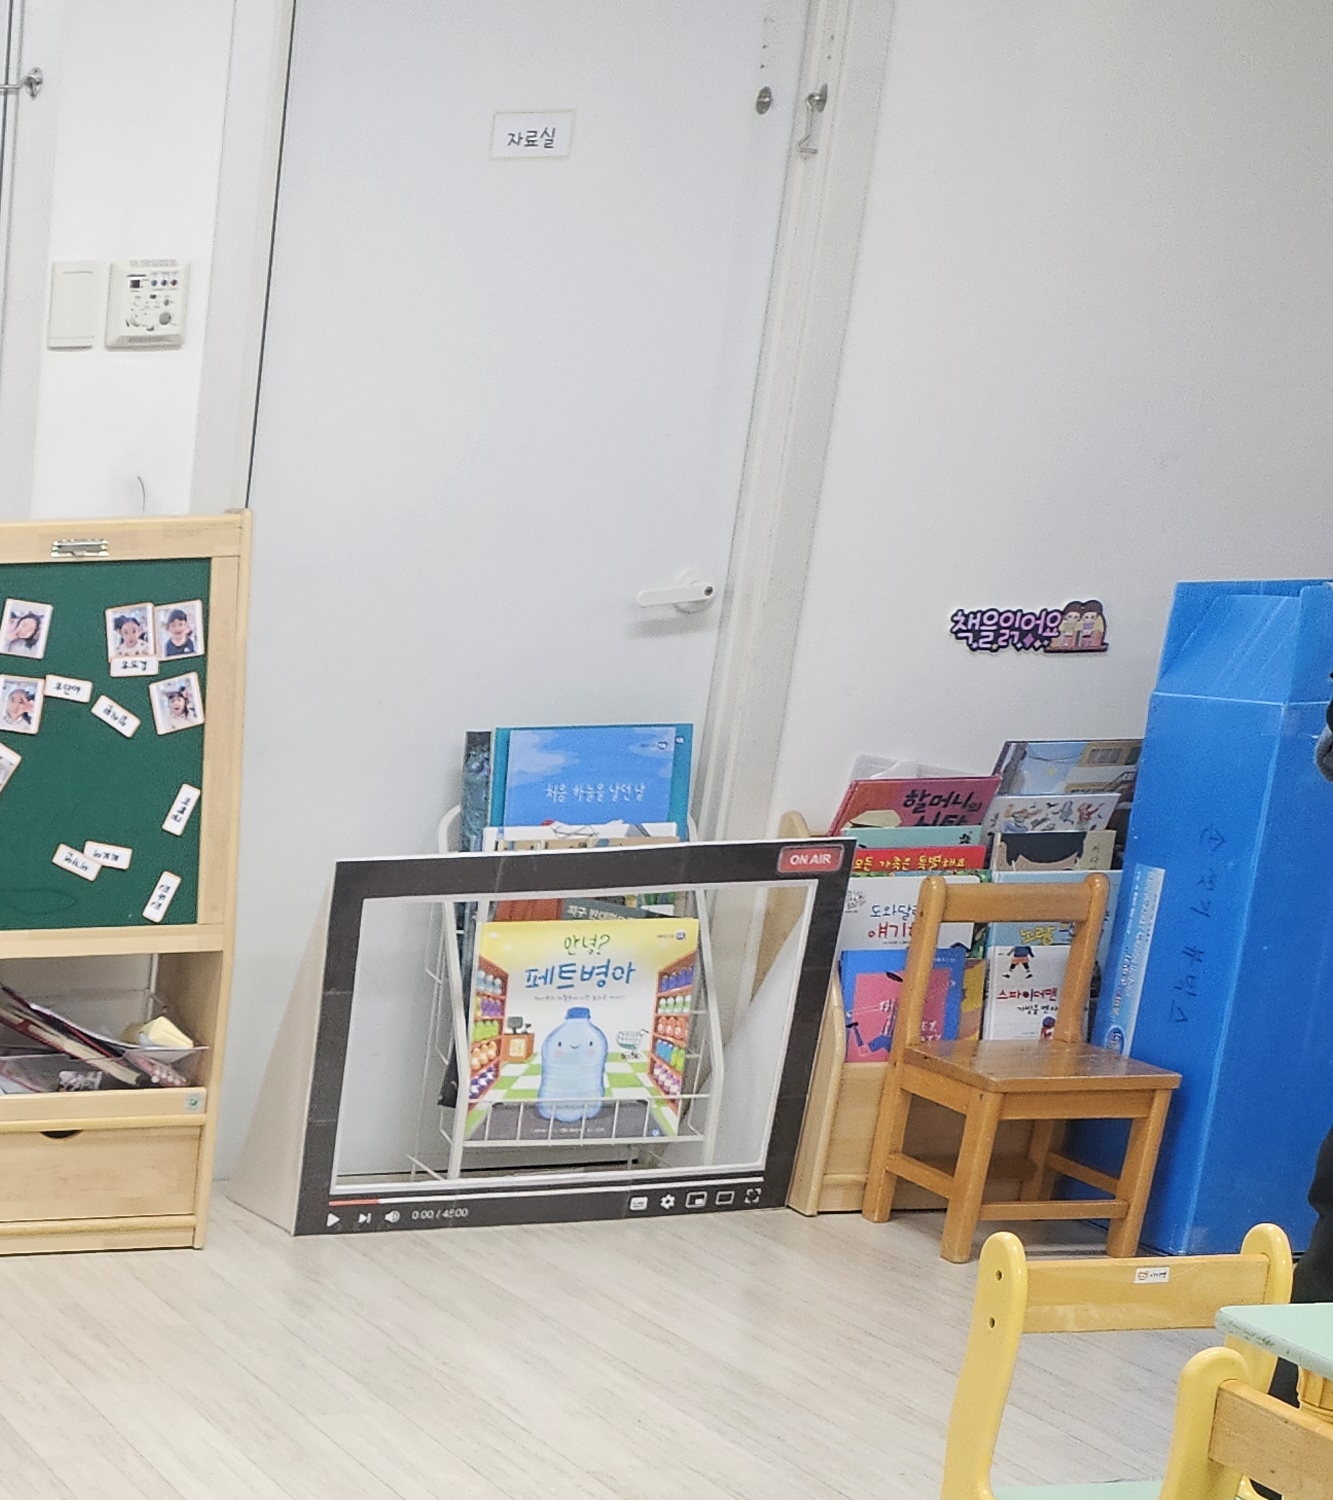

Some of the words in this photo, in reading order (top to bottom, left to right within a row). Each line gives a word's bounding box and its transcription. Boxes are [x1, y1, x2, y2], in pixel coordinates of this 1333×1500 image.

[507, 127, 556, 149] 자료실
[545, 783, 568, 803] 처음
[572, 783, 605, 803] 하늘을
[790, 854, 809, 865] ON
[809, 853, 832, 865] AIR
[564, 932, 611, 956] 안녕?
